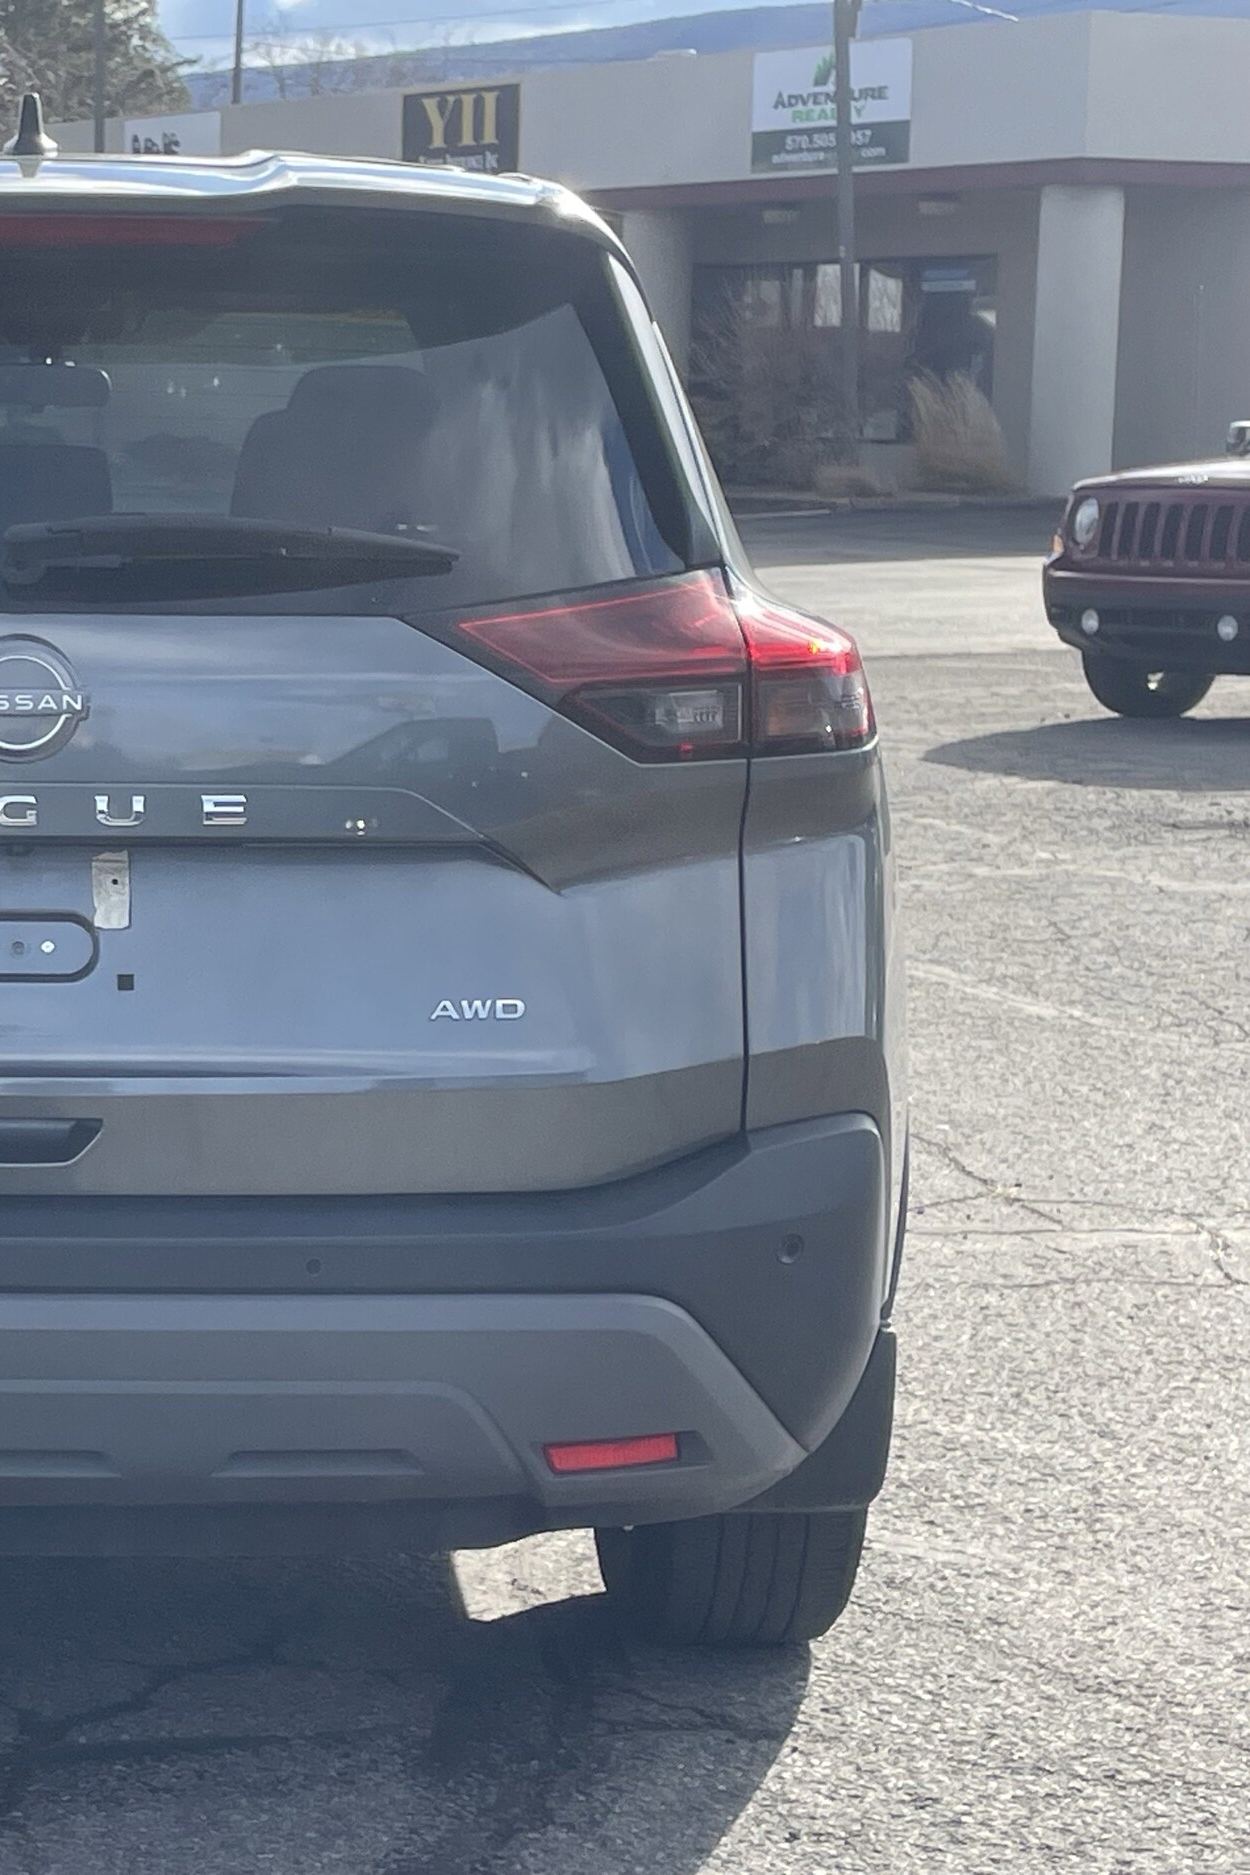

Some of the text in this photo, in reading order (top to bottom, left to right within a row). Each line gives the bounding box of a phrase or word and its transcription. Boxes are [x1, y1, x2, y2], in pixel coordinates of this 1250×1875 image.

[773, 86, 889, 109] ADVENURE
[422, 92, 500, 149] YII
[791, 104, 866, 123] REALY
[430, 999, 525, 1020] AWD
